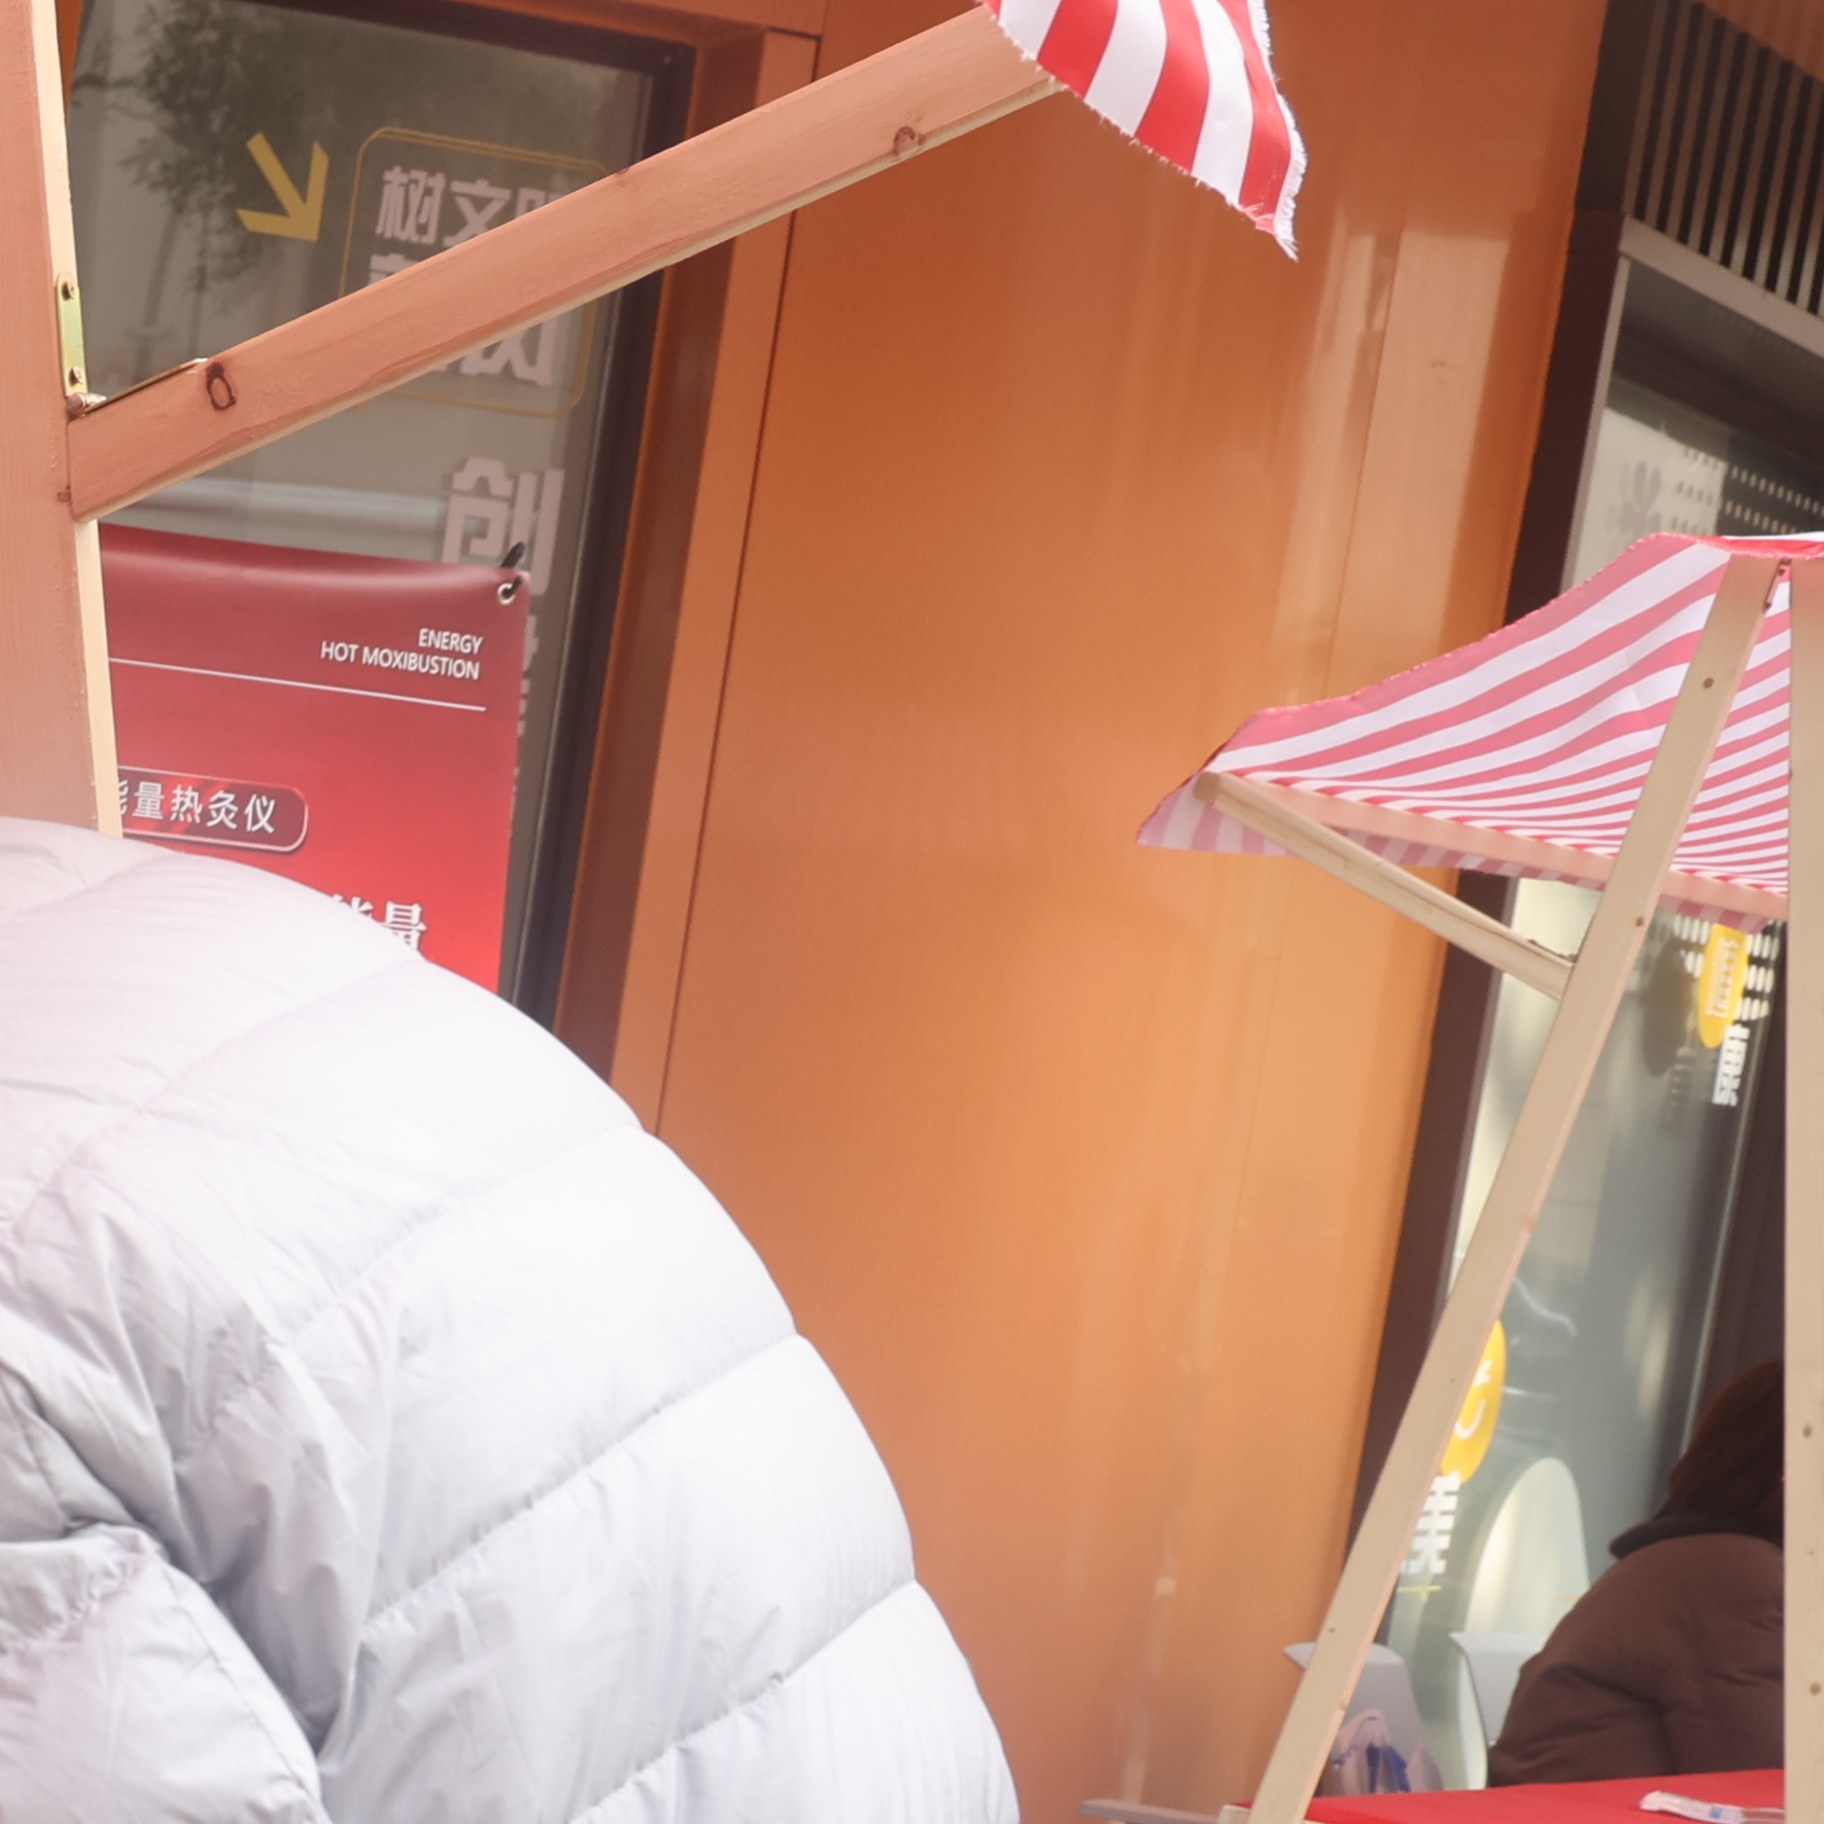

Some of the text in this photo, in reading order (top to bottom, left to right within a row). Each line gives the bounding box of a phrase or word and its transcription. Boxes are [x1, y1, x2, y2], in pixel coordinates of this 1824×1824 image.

[375, 166, 564, 247] 树文
[320, 639, 480, 681] HOT MOXIBUSTION
[418, 628, 483, 655] ENERGY
